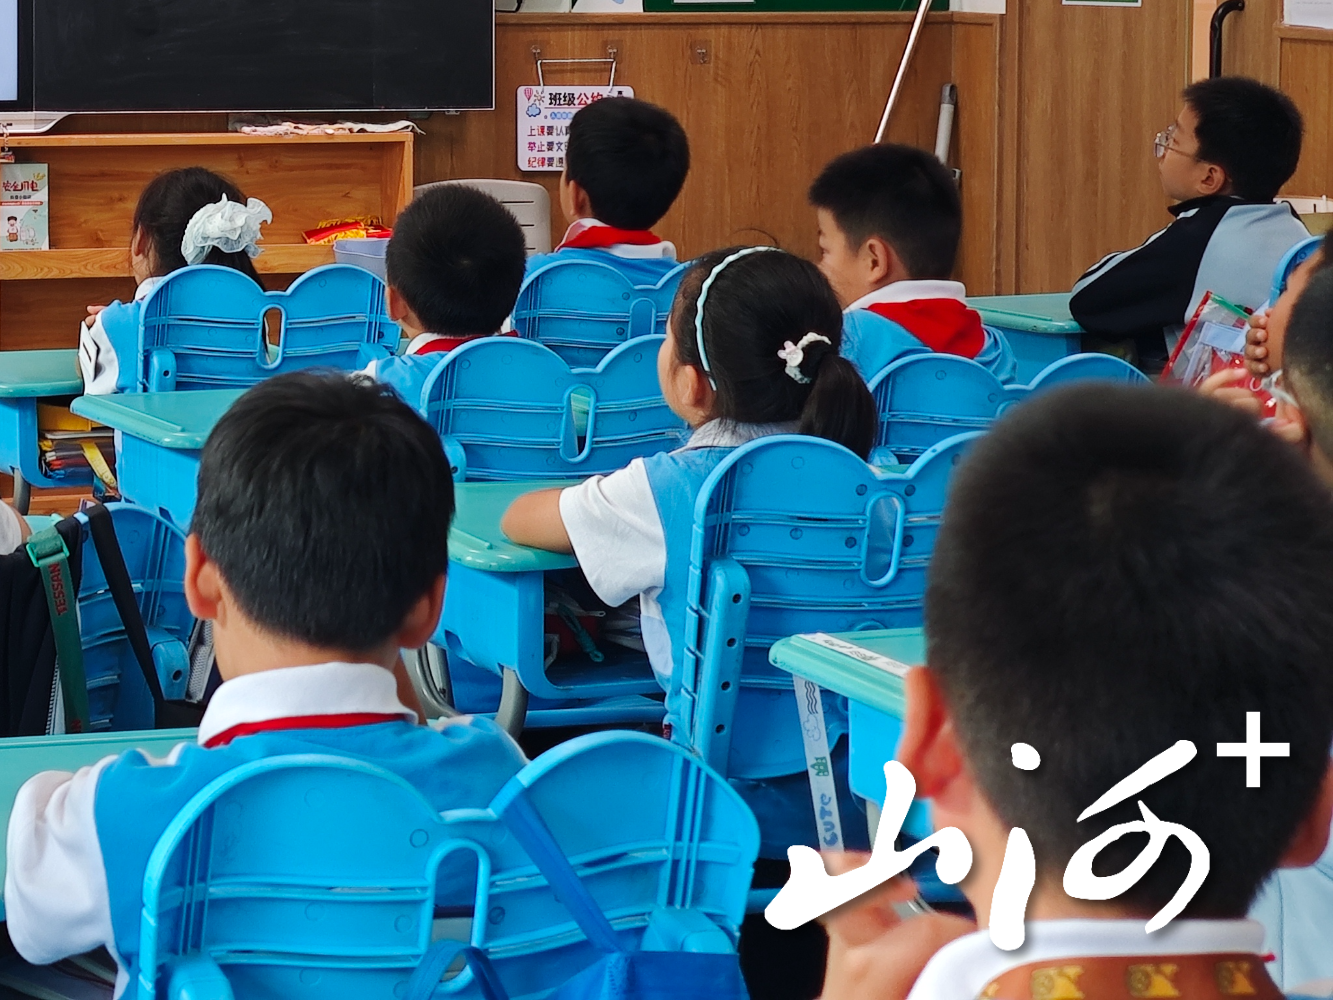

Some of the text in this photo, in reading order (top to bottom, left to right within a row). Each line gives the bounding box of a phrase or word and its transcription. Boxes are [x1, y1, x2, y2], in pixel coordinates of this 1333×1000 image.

[527, 141, 568, 152] 举止要文
[48, 561, 68, 616] TESSAN
